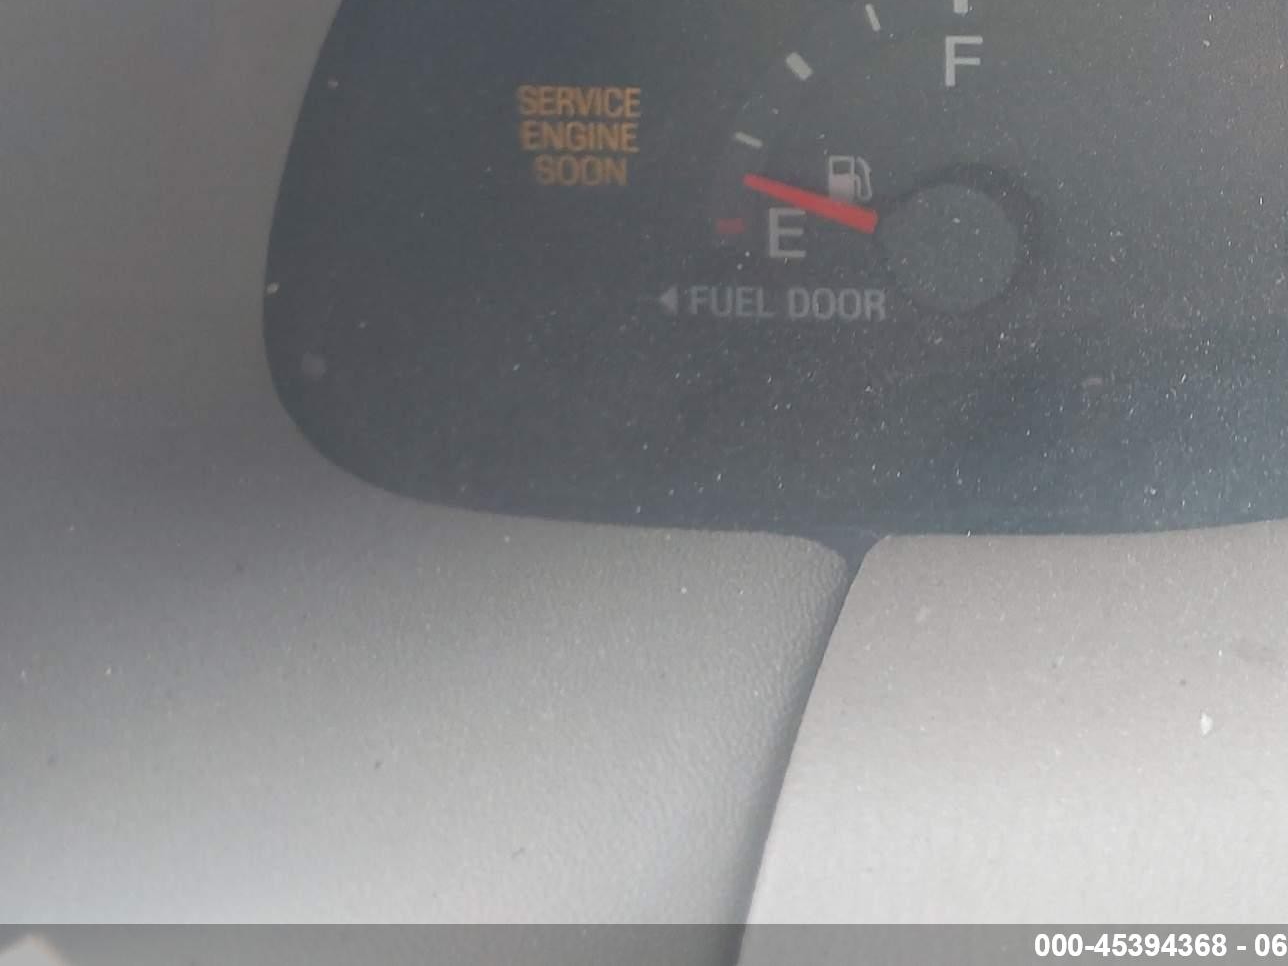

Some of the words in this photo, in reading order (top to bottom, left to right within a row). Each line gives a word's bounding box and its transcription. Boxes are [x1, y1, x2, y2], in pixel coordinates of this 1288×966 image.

[944, 36, 983, 87] F
[517, 85, 641, 118] SERVICE
[520, 120, 639, 153] ENGINE
[534, 154, 627, 186] SOON
[769, 208, 807, 258] E
[688, 287, 777, 318] FUEL
[788, 287, 888, 321] DOOR
